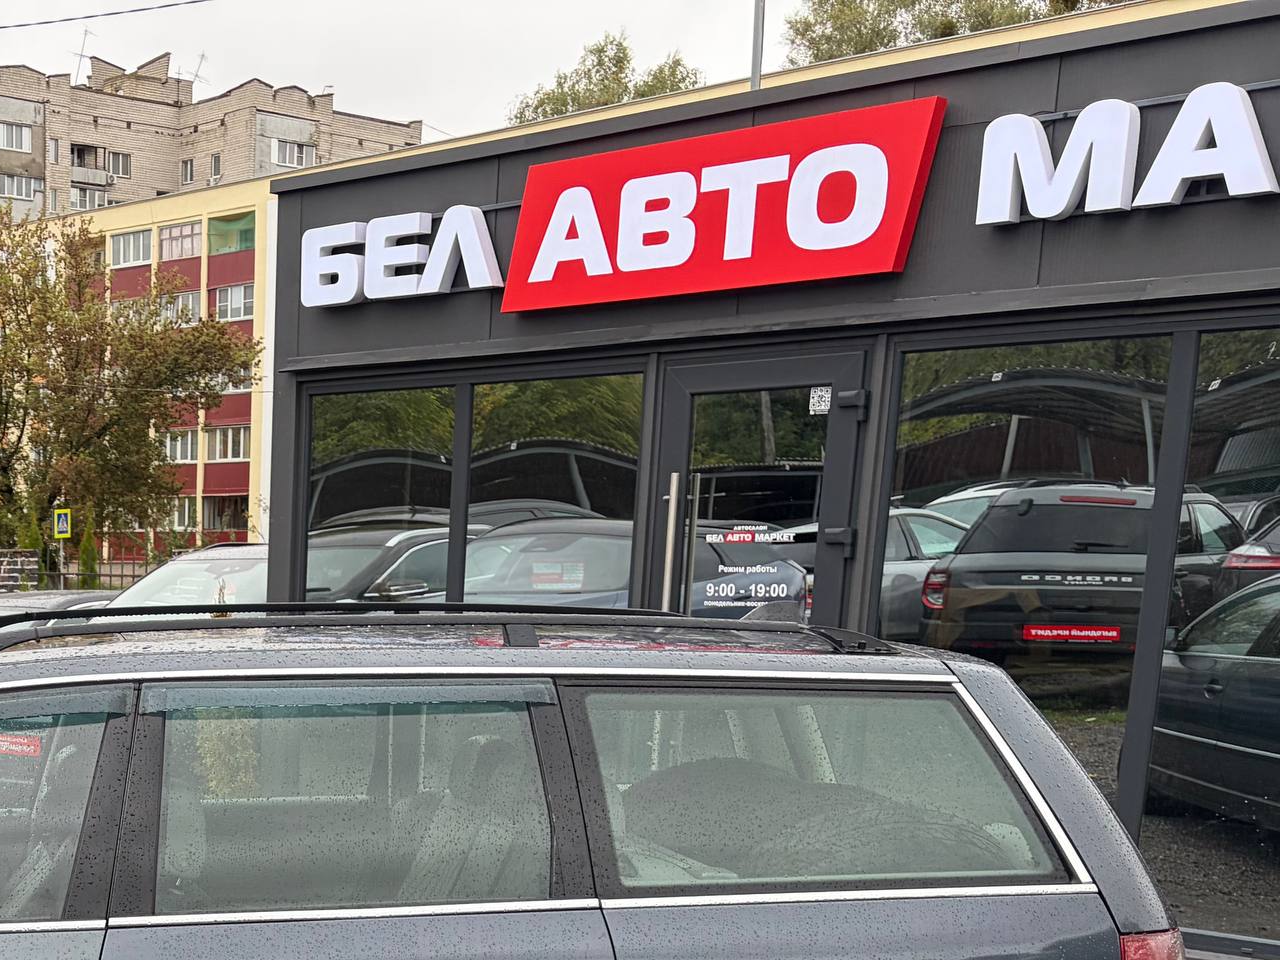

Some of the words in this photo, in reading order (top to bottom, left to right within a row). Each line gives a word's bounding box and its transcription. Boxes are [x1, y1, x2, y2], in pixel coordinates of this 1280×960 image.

[301, 204, 504, 308] БЕЛ
[528, 143, 889, 283] АВТО
[705, 534, 724, 543] БЕЛ
[726, 533, 752, 542] АВТО
[754, 533, 796, 543] МАРКЕТ
[718, 565, 745, 573] Режим
[746, 565, 777, 574] работы
[706, 583, 736, 597] 9:00
[749, 583, 788, 597] 19:00
